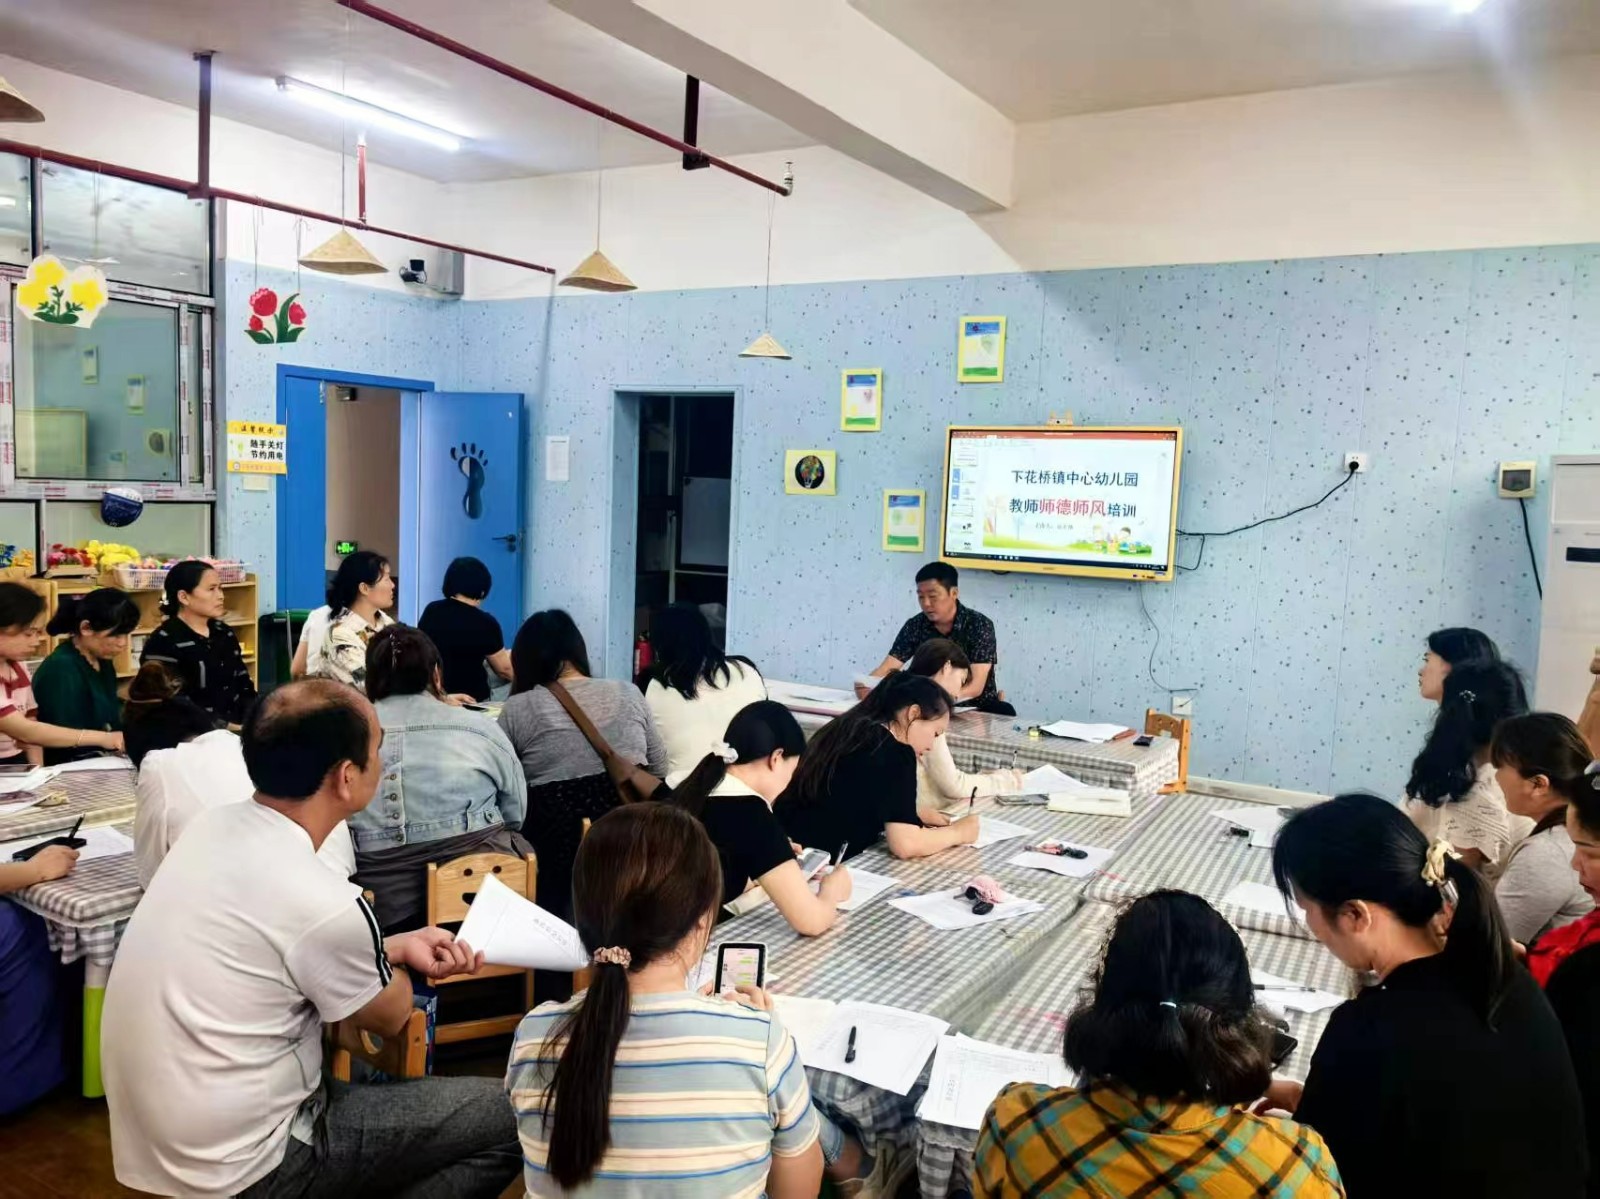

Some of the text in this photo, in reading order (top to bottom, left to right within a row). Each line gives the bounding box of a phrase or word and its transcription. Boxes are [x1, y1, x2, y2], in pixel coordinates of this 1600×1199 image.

[250, 439, 284, 450] 随手关灯
[250, 450, 284, 460] 节约用电
[1011, 469, 1139, 487] 下花桥镇中心幼儿园
[1008, 497, 1137, 518] 教师师德师风培训
